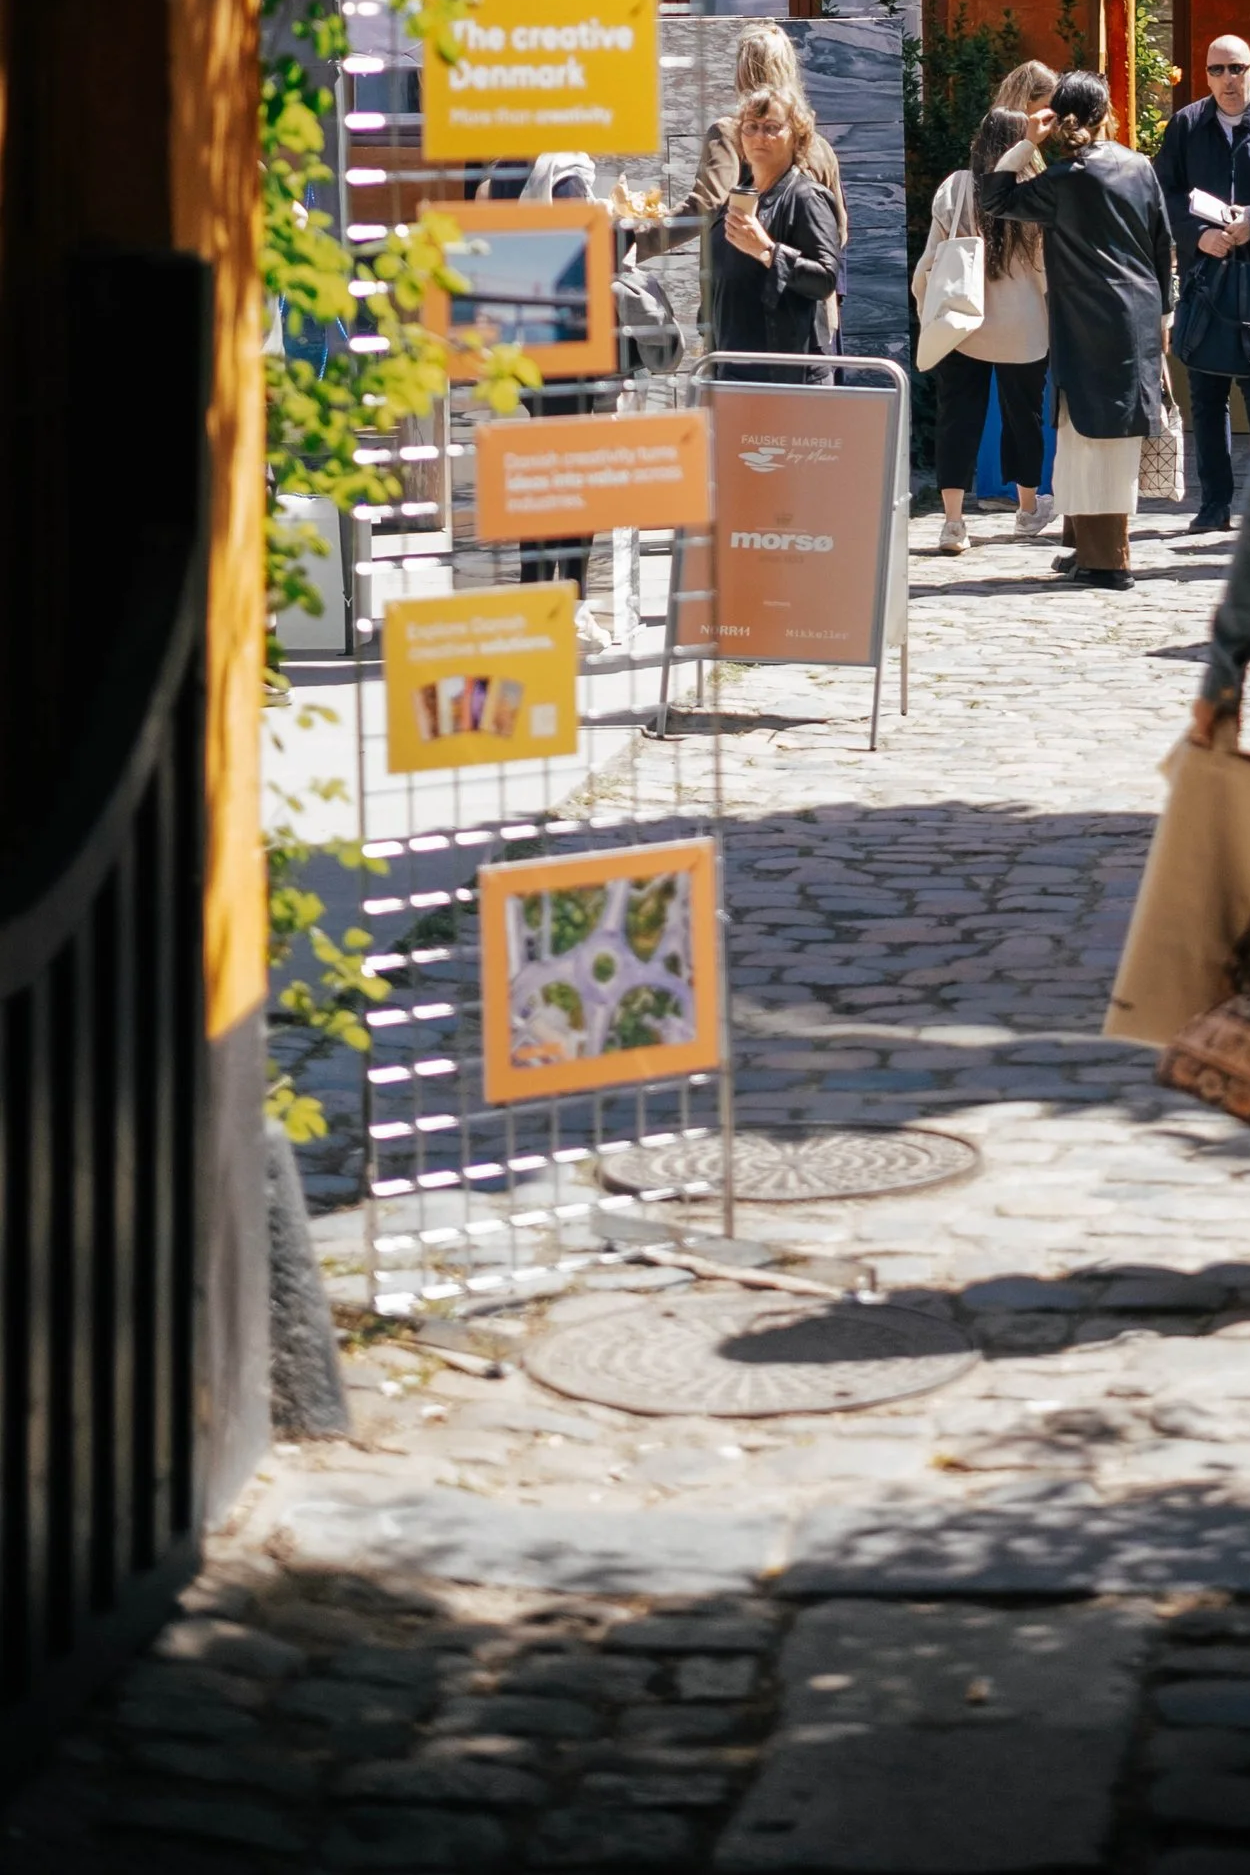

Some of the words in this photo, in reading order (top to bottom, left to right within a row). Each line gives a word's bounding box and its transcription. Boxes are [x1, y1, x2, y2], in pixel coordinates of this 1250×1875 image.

[452, 18, 506, 51] The
[511, 17, 634, 51] creative
[449, 56, 586, 91] Denmark
[536, 104, 612, 128] creativity
[741, 434, 787, 446] FAUSKE
[791, 437, 843, 448] MARBLE
[730, 532, 834, 552] morsø
[785, 629, 849, 640] Mikkeller
